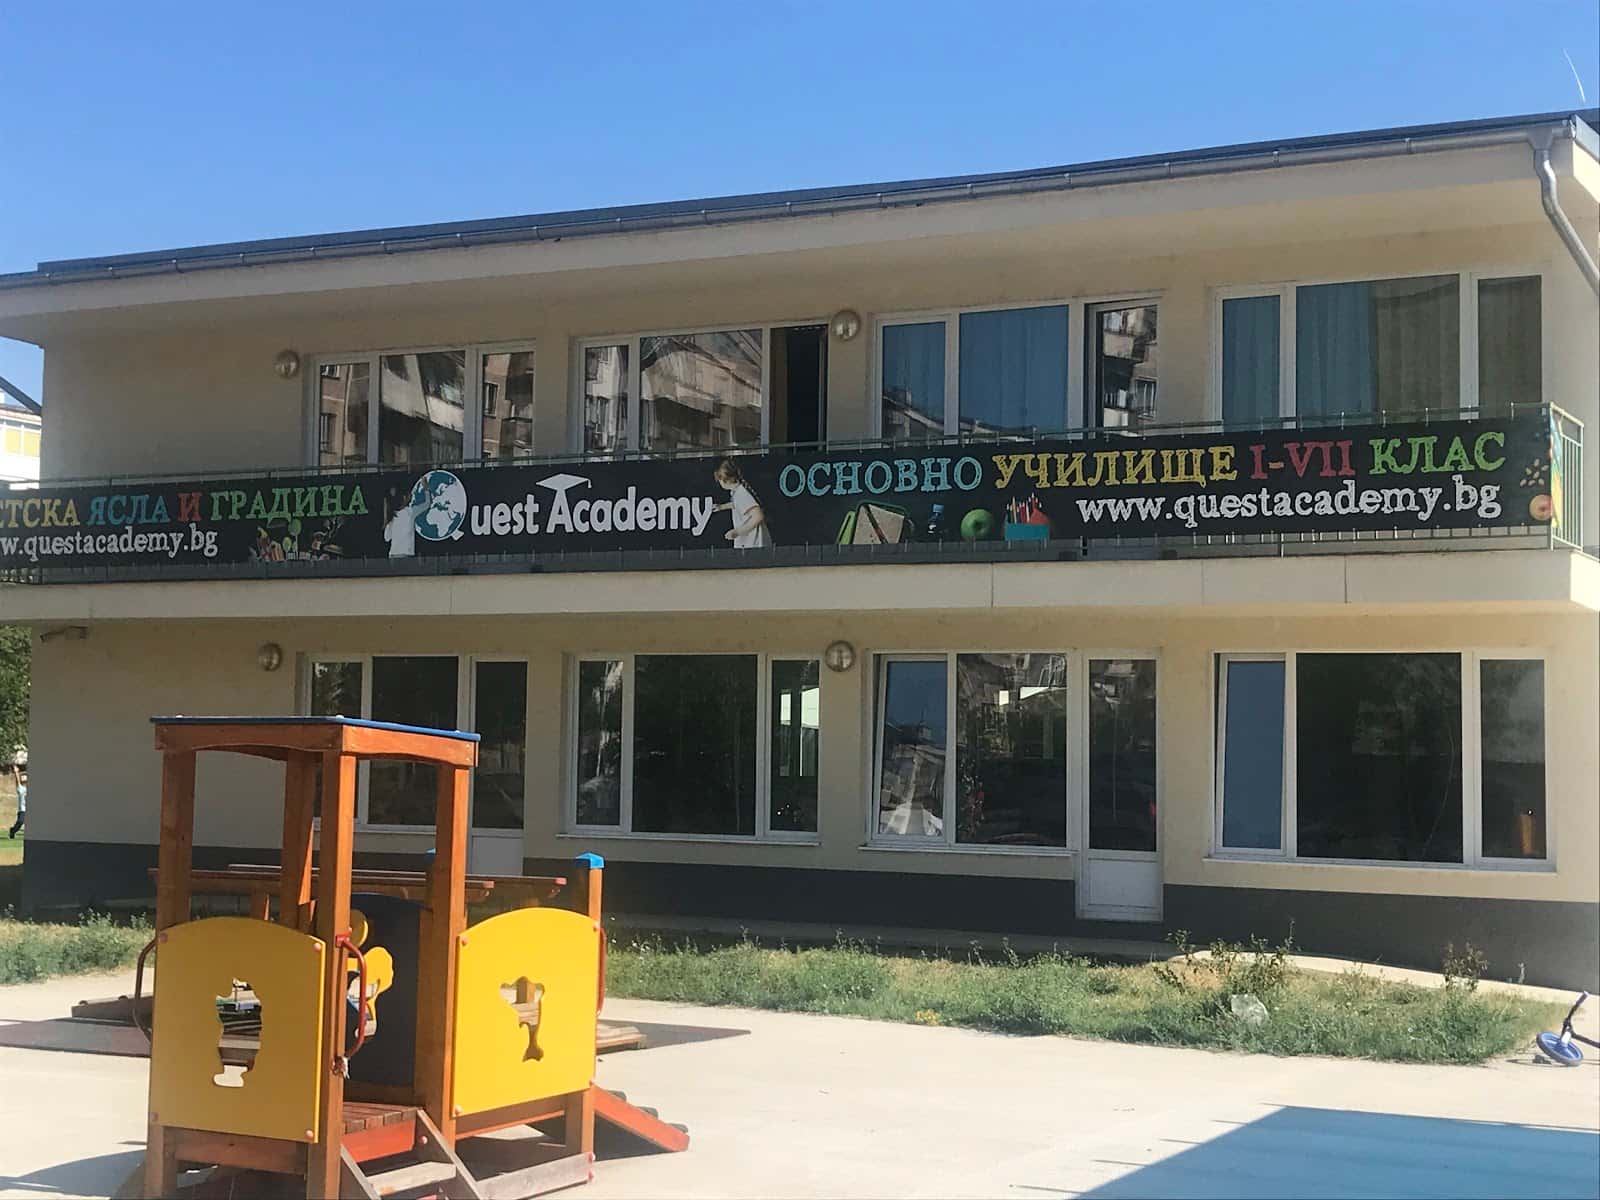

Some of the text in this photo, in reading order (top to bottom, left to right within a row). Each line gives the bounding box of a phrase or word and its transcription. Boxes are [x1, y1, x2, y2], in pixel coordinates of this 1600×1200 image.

[779, 456, 983, 497] ОСНОВНО
[992, 445, 1238, 489] УЧИЛИЩЕ
[1369, 432, 1505, 475] КЛАС
[0, 484, 369, 529] ТСКА ЯСЛА И ГРАДИНА
[546, 484, 713, 535] Academy
[1076, 474, 1502, 528] www.questacademy.bg
